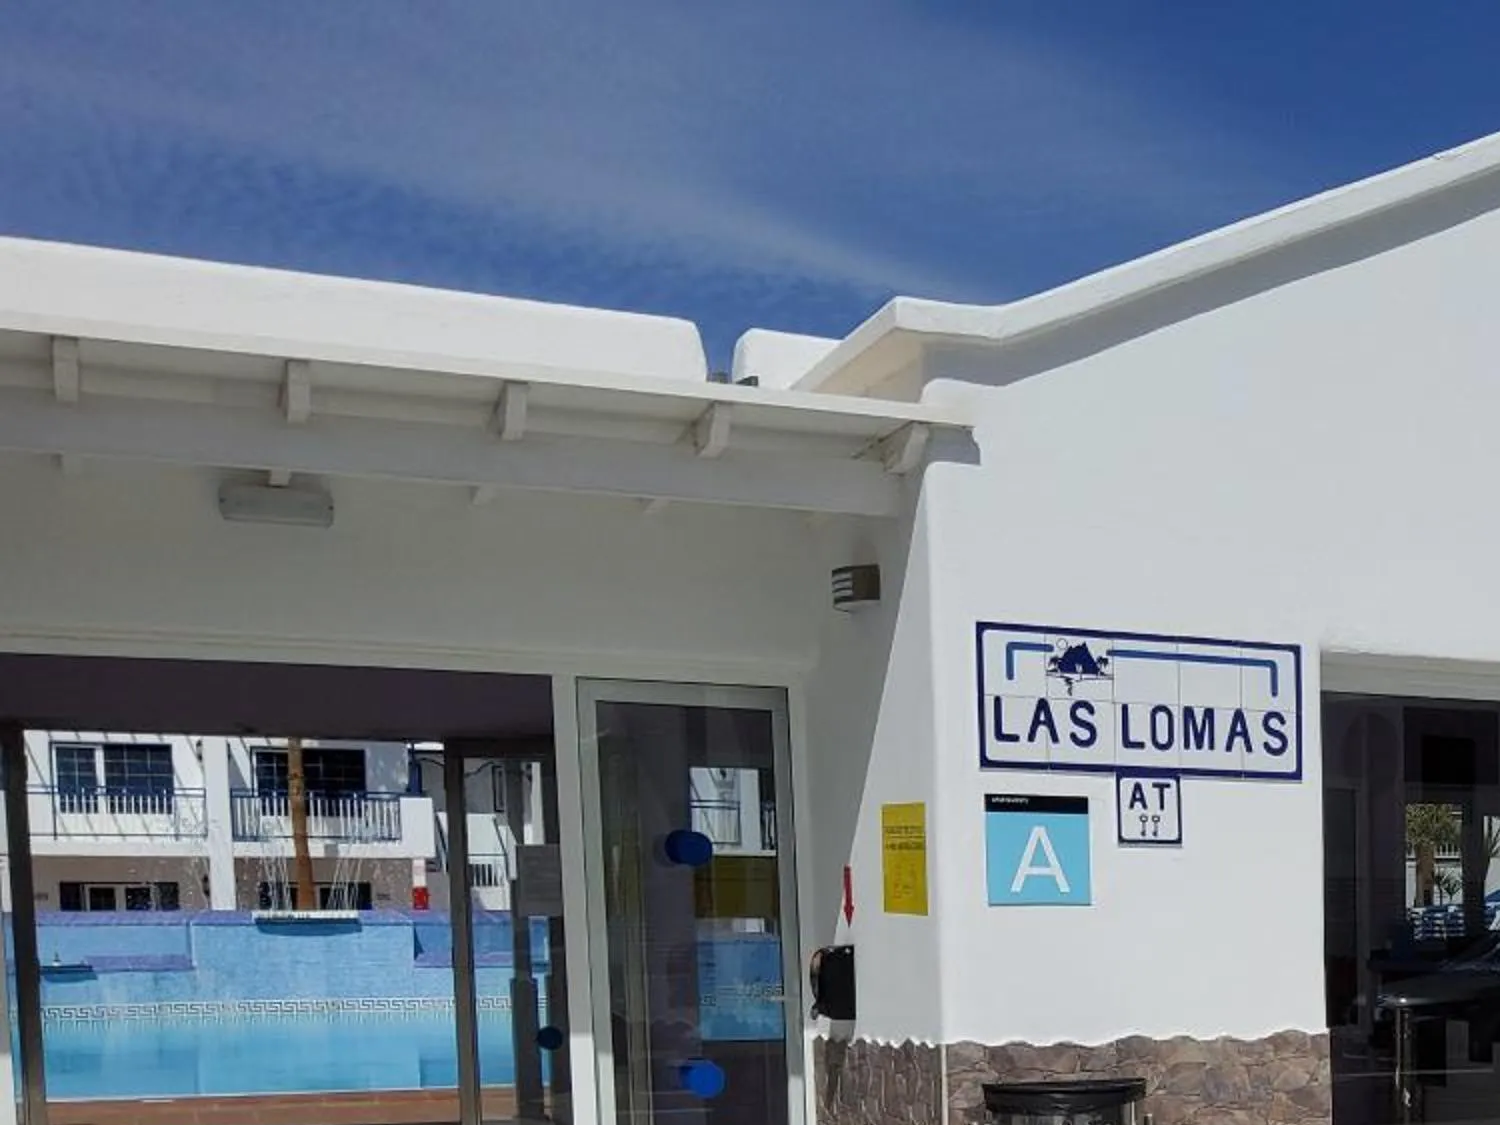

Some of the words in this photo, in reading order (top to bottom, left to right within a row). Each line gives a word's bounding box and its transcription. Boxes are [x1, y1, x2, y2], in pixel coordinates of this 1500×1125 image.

[994, 696, 1098, 748] LAS
[1121, 703, 1289, 757] LOMAS
[1128, 782, 1171, 811] AT
[1010, 825, 1071, 893] A
